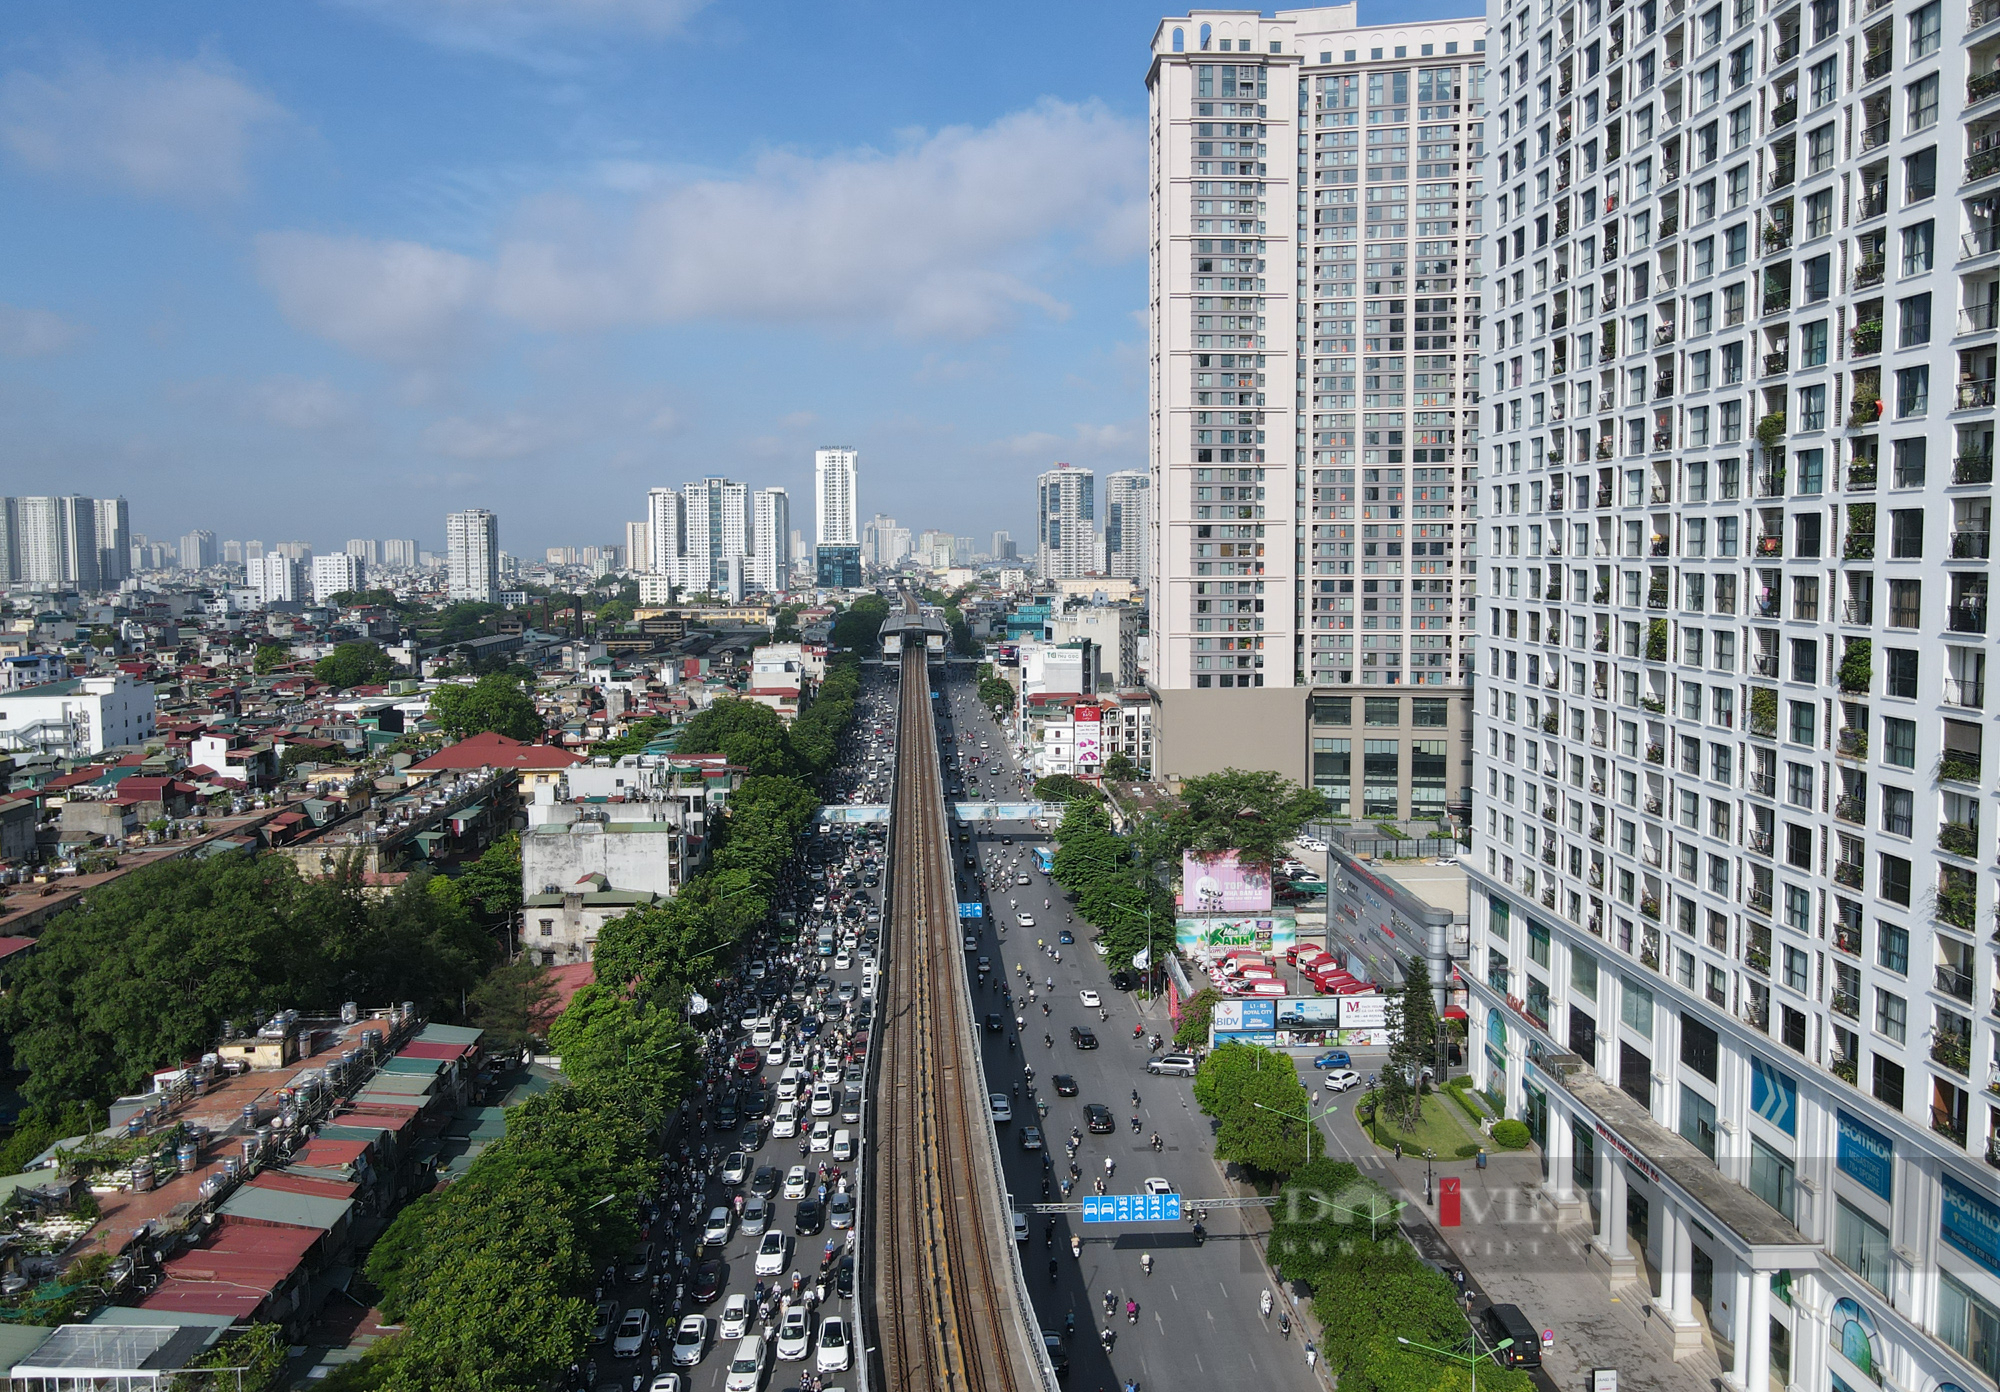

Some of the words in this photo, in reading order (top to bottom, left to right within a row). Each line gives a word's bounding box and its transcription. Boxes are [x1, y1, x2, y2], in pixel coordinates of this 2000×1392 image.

[1223, 881, 1243, 890] TOP
[1295, 1002, 1305, 1014] 5
[1216, 1017, 1240, 1026] BIDV
[1838, 1117, 1892, 1163] DECATHLON
[1849, 1149, 1881, 1176] MEGASTORE
[1943, 1184, 2000, 1235] DECATHLO
